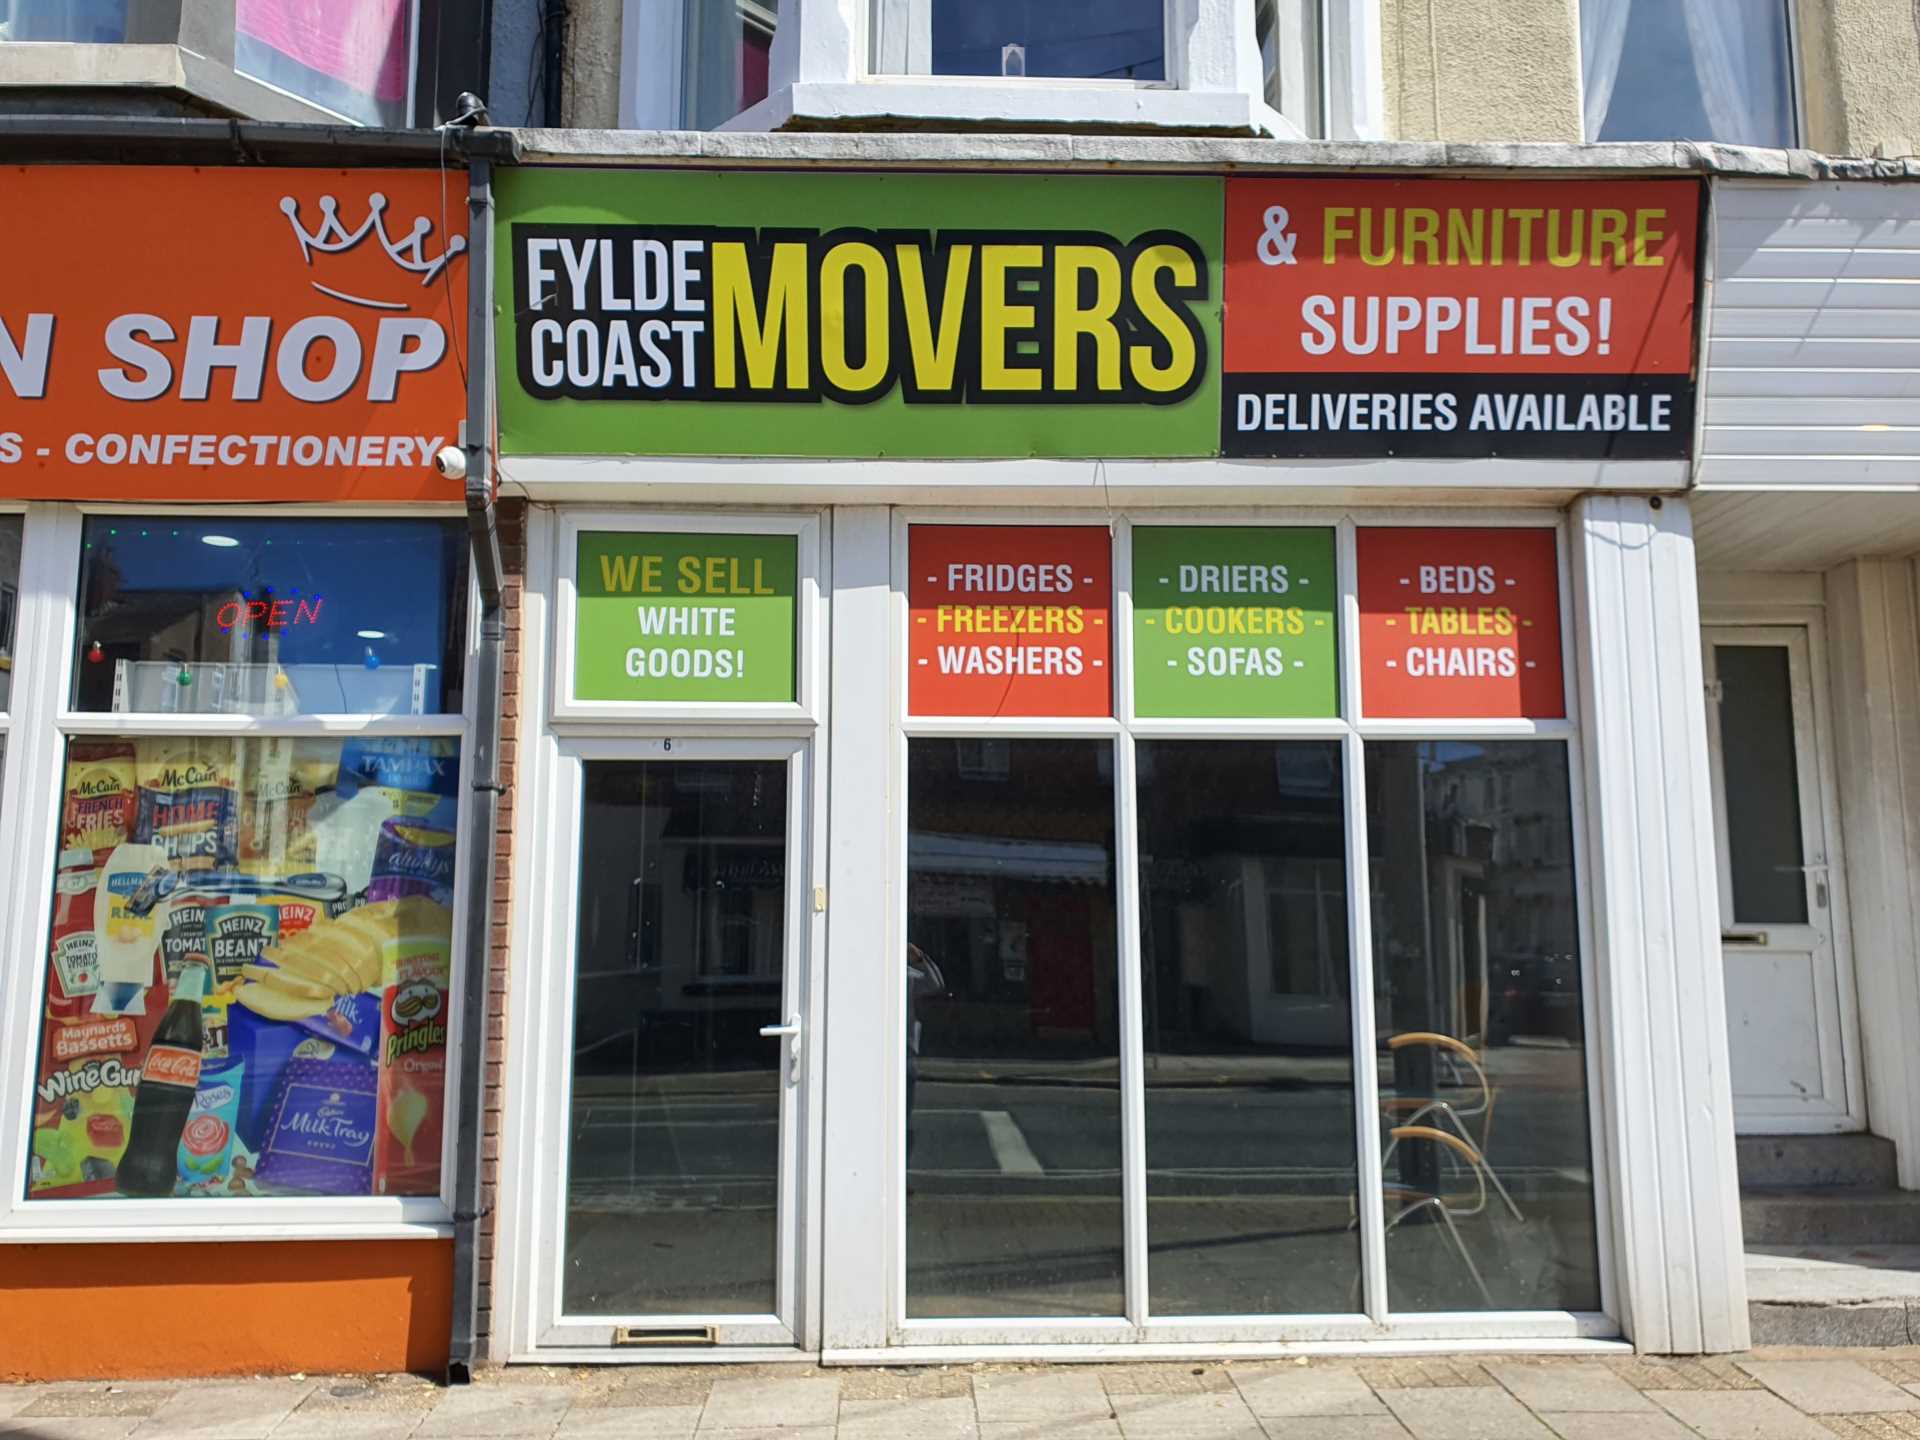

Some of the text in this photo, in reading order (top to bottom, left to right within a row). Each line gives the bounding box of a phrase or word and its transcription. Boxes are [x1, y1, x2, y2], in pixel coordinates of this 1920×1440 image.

[1257, 205, 1665, 268] & FURNITURE
[527, 238, 705, 311] FYLDE
[711, 241, 1198, 392] MOVERS
[1301, 294, 1612, 356] SUPPLIES!
[97, 312, 446, 402] SHOP
[530, 319, 704, 388] COAST
[1236, 393, 1671, 433] DELIVERIES AVAILABLE
[64, 432, 445, 467] CONFECTIONERY
[600, 554, 775, 596] WE SELL
[947, 563, 1074, 593] FRIDGES
[1178, 564, 1289, 594] DRIERS
[1419, 565, 1496, 595] BEDS
[217, 599, 322, 628] OPEN
[638, 606, 736, 637] WHITE
[936, 605, 1084, 634] FREEZERS
[1165, 606, 1305, 636] COOKERS
[1404, 606, 1514, 637] TABLES
[625, 647, 745, 679] GOODS!
[937, 645, 1084, 676] WASHERS
[1187, 646, 1283, 678] SOFAS
[1405, 646, 1516, 678] CHAIRS
[664, 737, 671, 751] 6
[79, 780, 121, 796] McCain
[161, 766, 218, 787] McCain
[76, 809, 124, 830] FRIES
[78, 799, 124, 815] FRENCH
[153, 801, 220, 827] HOME
[222, 917, 263, 934] HEINZ
[278, 905, 313, 921] EINZ
[65, 939, 95, 951] HEINZ
[55, 1034, 133, 1056] Bassetts
[62, 1022, 127, 1040] Maynards
[280, 1111, 370, 1148] Milk Tray
